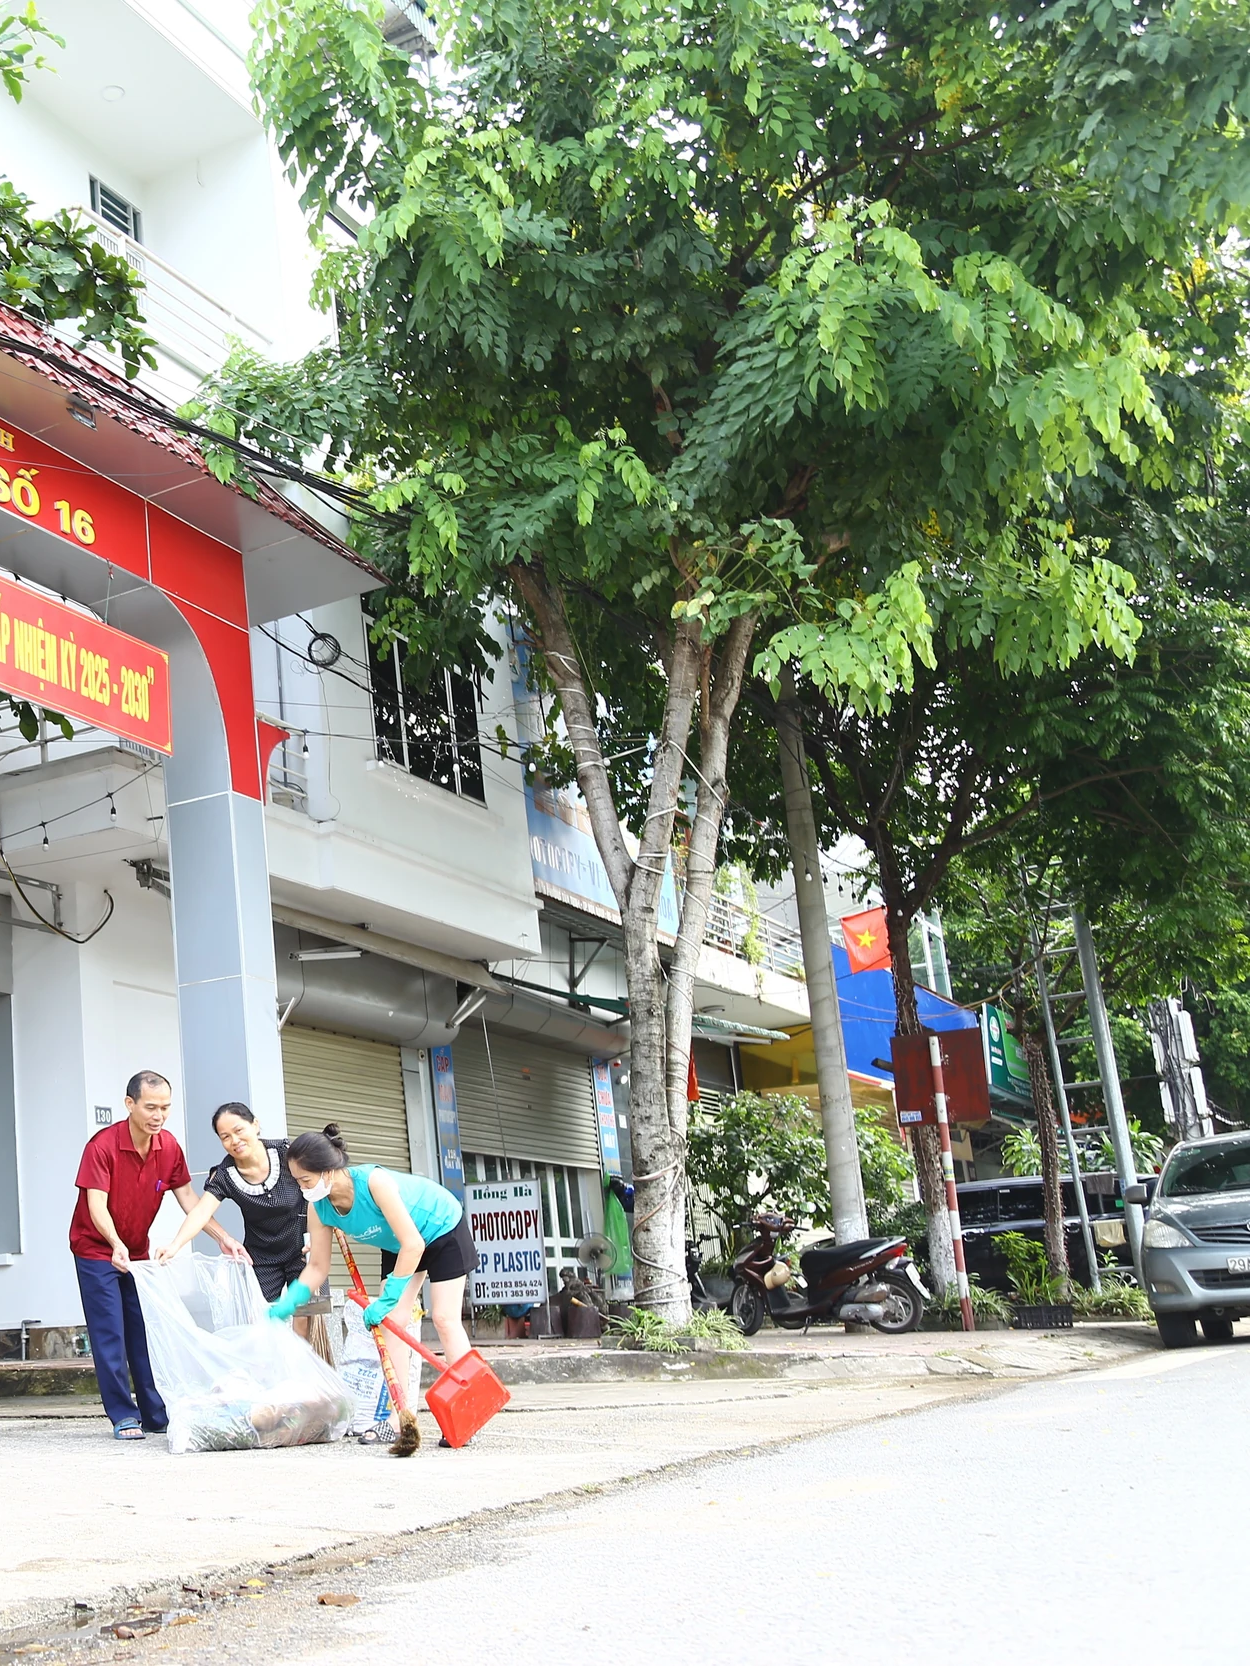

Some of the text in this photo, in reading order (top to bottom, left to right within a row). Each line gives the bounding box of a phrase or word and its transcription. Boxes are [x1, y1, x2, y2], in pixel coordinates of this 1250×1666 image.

[54, 499, 96, 545] 16
[13, 617, 58, 692] NHIỆM
[60, 631, 77, 693] KỲ
[80, 648, 111, 707] 2025
[112, 683, 119, 695] -
[530, 834, 582, 880] OTOCOPY
[96, 1109, 111, 1123] 130
[472, 1184, 532, 1202] Hồng Hà
[471, 1209, 538, 1242] PHOTOCOPY
[494, 1250, 541, 1273] PLASTIC
[1230, 1259, 1250, 1274] 29
[475, 1279, 542, 1299] ĐT: 02183 854 424
[525, 1289, 538, 1297] 993
